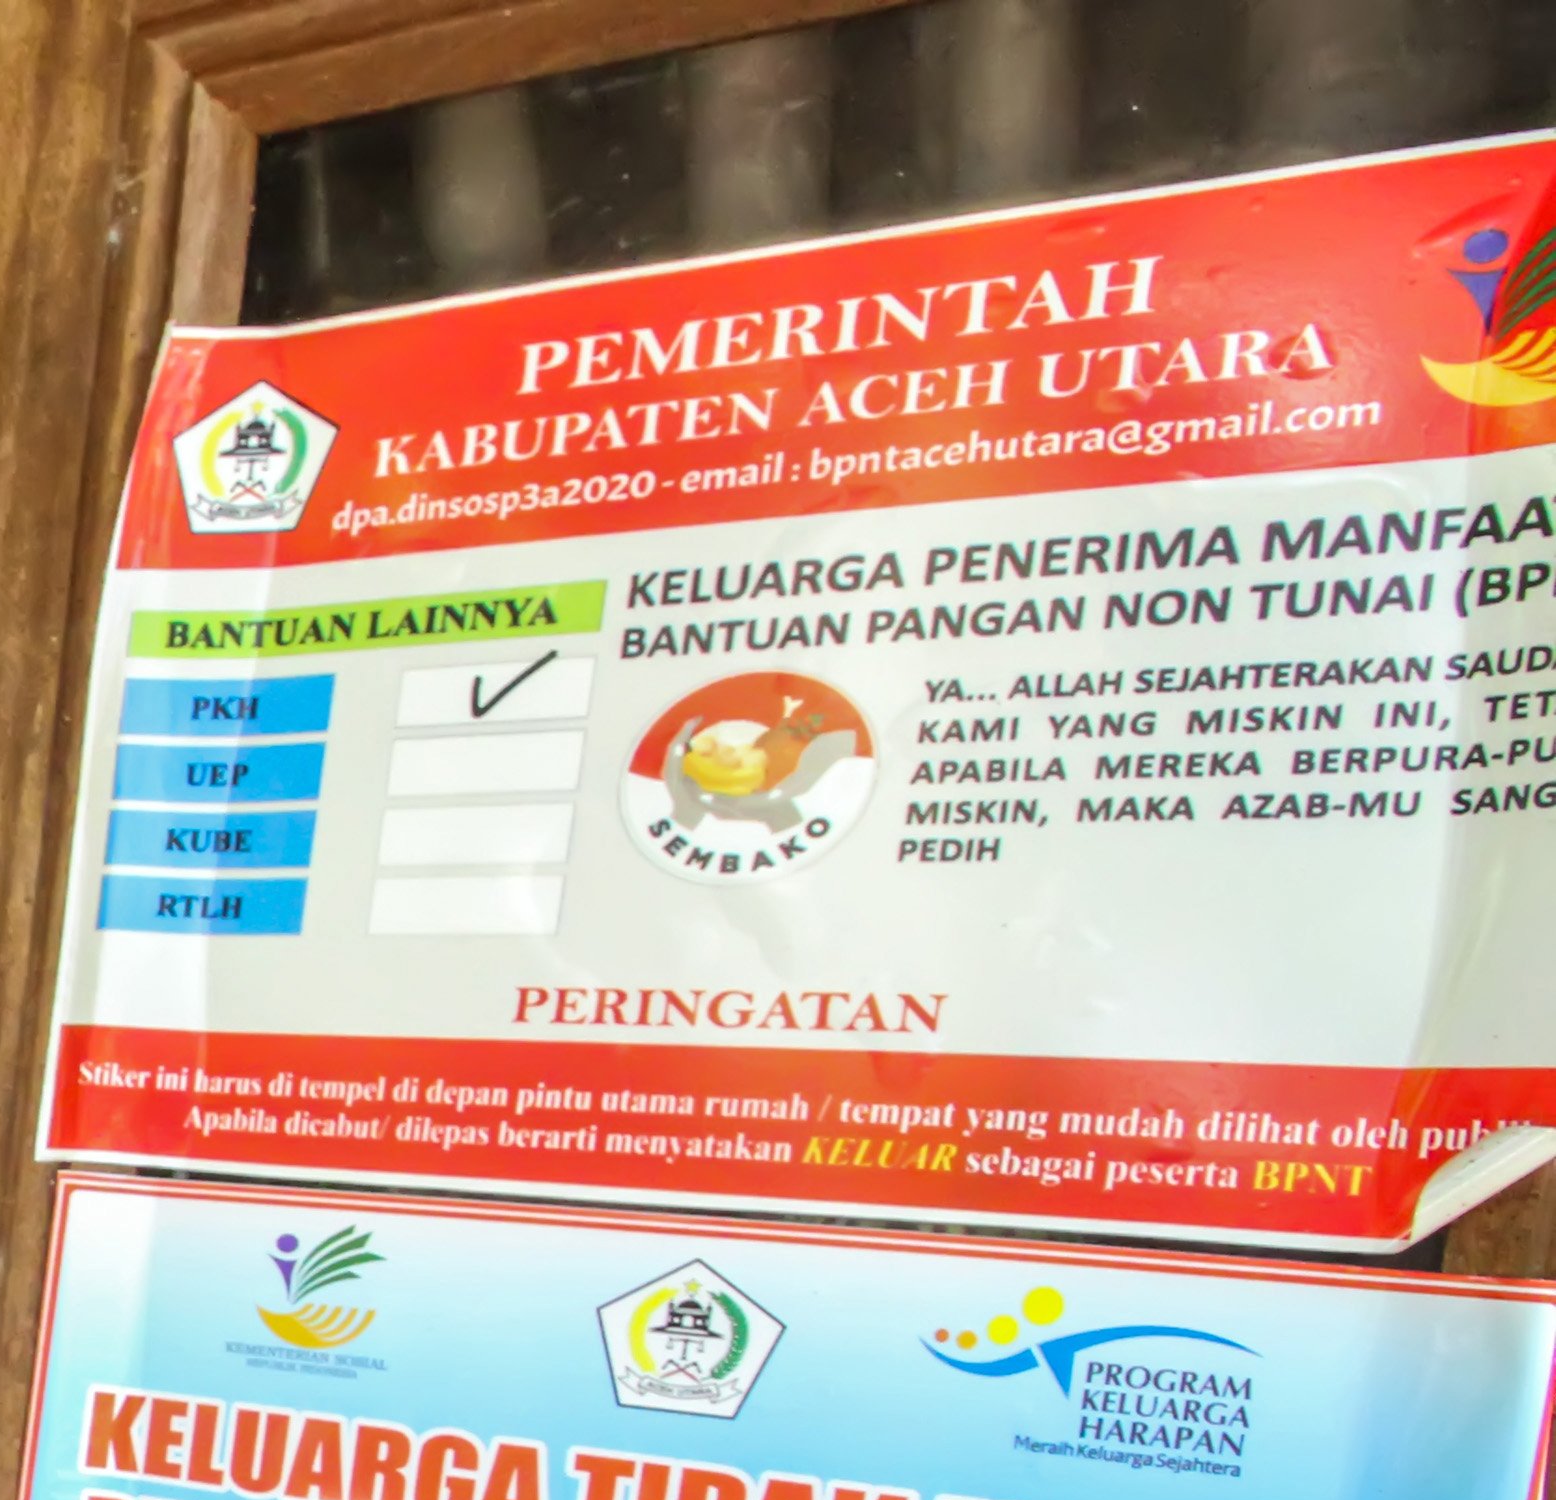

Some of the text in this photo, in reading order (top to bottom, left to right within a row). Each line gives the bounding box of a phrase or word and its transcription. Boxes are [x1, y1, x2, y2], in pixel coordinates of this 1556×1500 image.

[516, 256, 1164, 394] PEMERINTAH
[373, 323, 1334, 478] KABUPATEN ACEH UTARA
[332, 470, 656, 533] dpa.dinsosp3a2020
[680, 453, 783, 491] email
[810, 401, 1381, 484] bpntacehutara@gmail.com
[626, 495, 1556, 607] KELUARGA PENERIMA MANFAA
[166, 598, 558, 650] BANTUAN LAINNYA
[619, 561, 1556, 659] BANTUAN PANGAN NON TUNAI (BP
[925, 646, 1556, 703] YA... ALLAH SEJAHTERAKAN SAUD
[191, 697, 260, 720] PKH
[917, 690, 1556, 744] KAMI YANG MISKIN INI, TET
[187, 762, 250, 788] UEP
[909, 756, 1067, 785] APABILA
[1093, 751, 1261, 779] MEREKA
[905, 801, 1048, 828] MISKIN,
[1076, 796, 1194, 823] MAKA
[1221, 791, 1421, 820] AZAB-MU
[165, 829, 253, 854] KUBE
[648, 816, 830, 873] SEMBAKO
[897, 837, 1001, 863] PEDIH
[155, 895, 245, 920] RTLH
[511, 987, 947, 1034] PERINGATAN
[78, 1061, 151, 1089] Stiker
[156, 1066, 189, 1093] ini
[194, 1067, 262, 1096] harus
[268, 1071, 293, 1097] di
[298, 1074, 385, 1110] tempel
[393, 1077, 419, 1103] di
[425, 1078, 508, 1114] depan
[515, 1082, 590, 1118] pintu
[600, 1088, 694, 1116] utama
[703, 1093, 809, 1121] rumah
[838, 1098, 955, 1131] tempat
[962, 1109, 1049, 1139] yang
[1059, 1106, 1185, 1141] mudah
[1196, 1110, 1325, 1147] dilihat
[1331, 1117, 1409, 1150] oleh
[184, 1106, 1373, 1197] Apabila dicabut/ dilepas berarti menyatakan KELUAR sebagai peserta BPNT
[1086, 1361, 1252, 1400] PROGRAM
[1081, 1389, 1249, 1428] KELUARGA
[1013, 1434, 1241, 1477] Meraih Keluarga Sejahtera
[1078, 1416, 1245, 1457] HARAPAN
